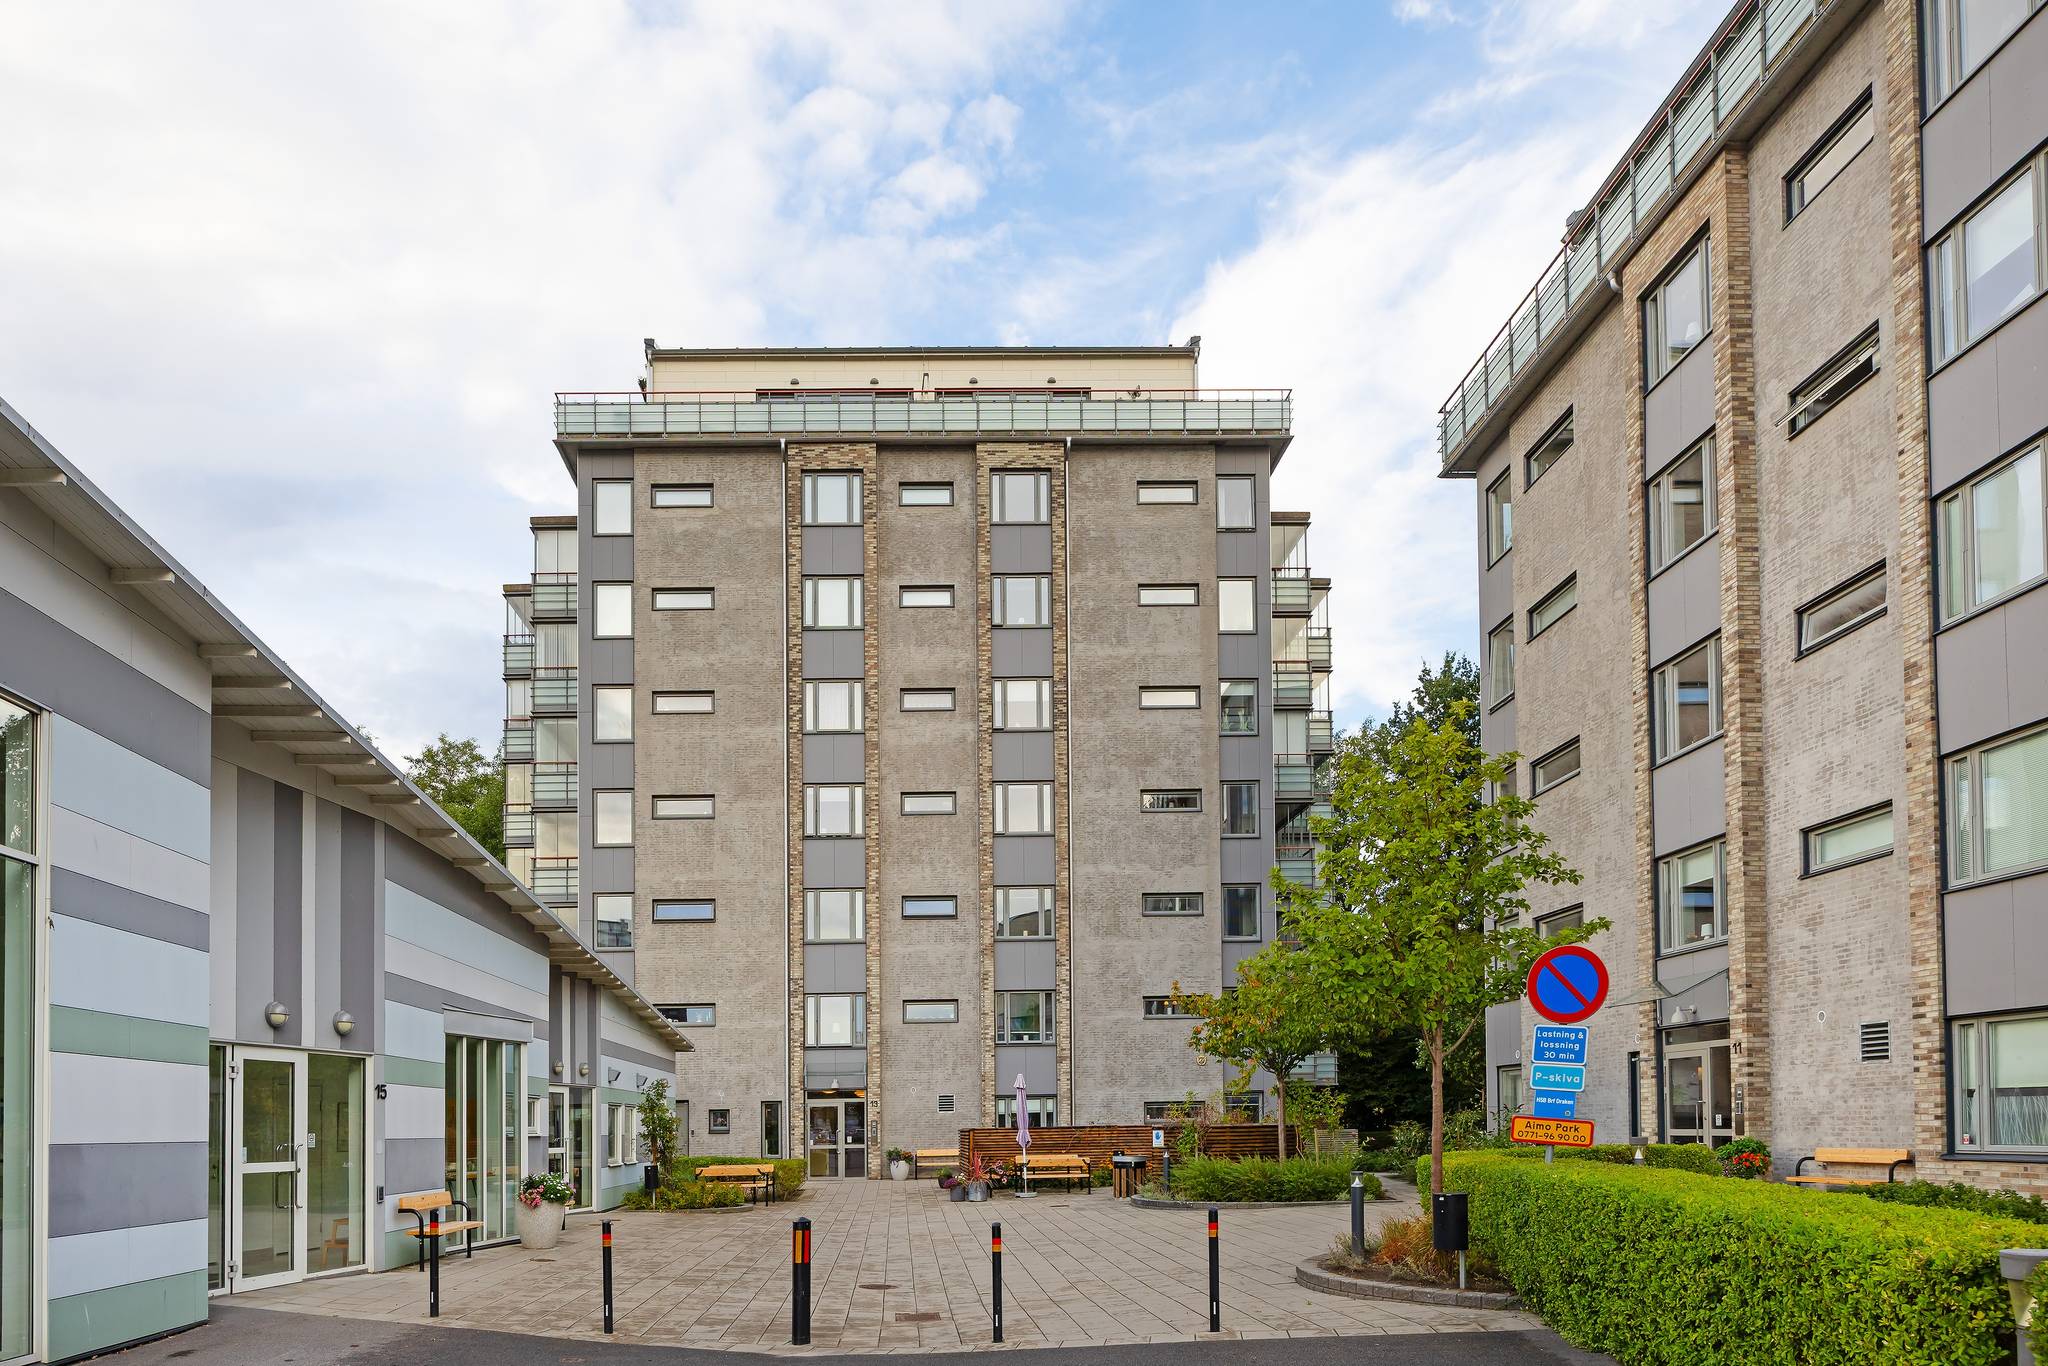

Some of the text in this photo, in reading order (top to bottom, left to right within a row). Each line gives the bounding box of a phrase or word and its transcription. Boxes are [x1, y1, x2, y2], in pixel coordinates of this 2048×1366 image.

[1537, 1030, 1584, 1040] Lastning &
[1540, 1040, 1580, 1051] lossning
[1732, 1042, 1742, 1054] 11
[1543, 1051, 1575, 1060] 30 min
[1535, 1072, 1580, 1083] P-skiva
[374, 1084, 387, 1100] 15
[869, 1100, 879, 1108] 13
[1524, 1121, 1580, 1133] Aimo Park
[1517, 1130, 1587, 1143] 0771-96 90 00
